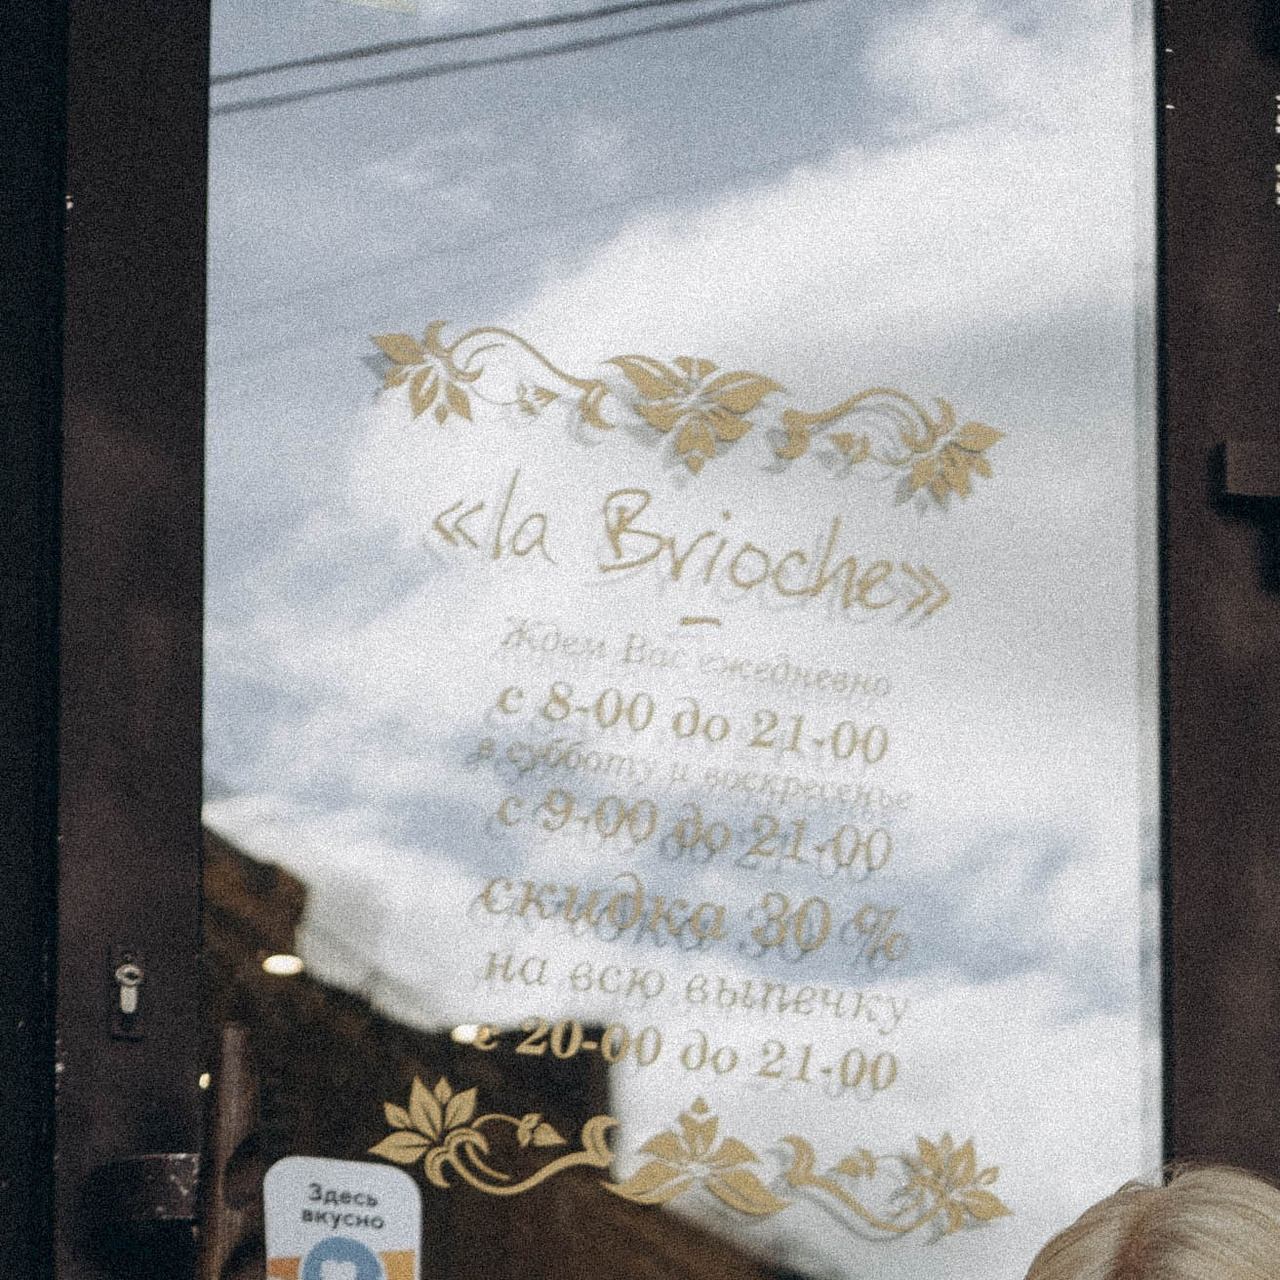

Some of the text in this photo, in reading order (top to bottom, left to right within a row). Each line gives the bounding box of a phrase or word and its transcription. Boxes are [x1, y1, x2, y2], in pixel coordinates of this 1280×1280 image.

[622, 632, 687, 669] Вас
[699, 653, 891, 698] ежедневно
[498, 680, 890, 766] с 8-00 до 21-00
[506, 738, 656, 788] субботу
[499, 788, 895, 872] с 9-00 до 21-00
[482, 872, 730, 943] скидка
[751, 890, 833, 954] 30
[484, 951, 912, 1037] на всю выпечку
[515, 1016, 664, 1067] 20-00
[680, 1029, 739, 1076] до
[757, 1039, 898, 1092] 21-00
[302, 1208, 386, 1230] вкусно
[308, 1182, 379, 1208] Здесь
